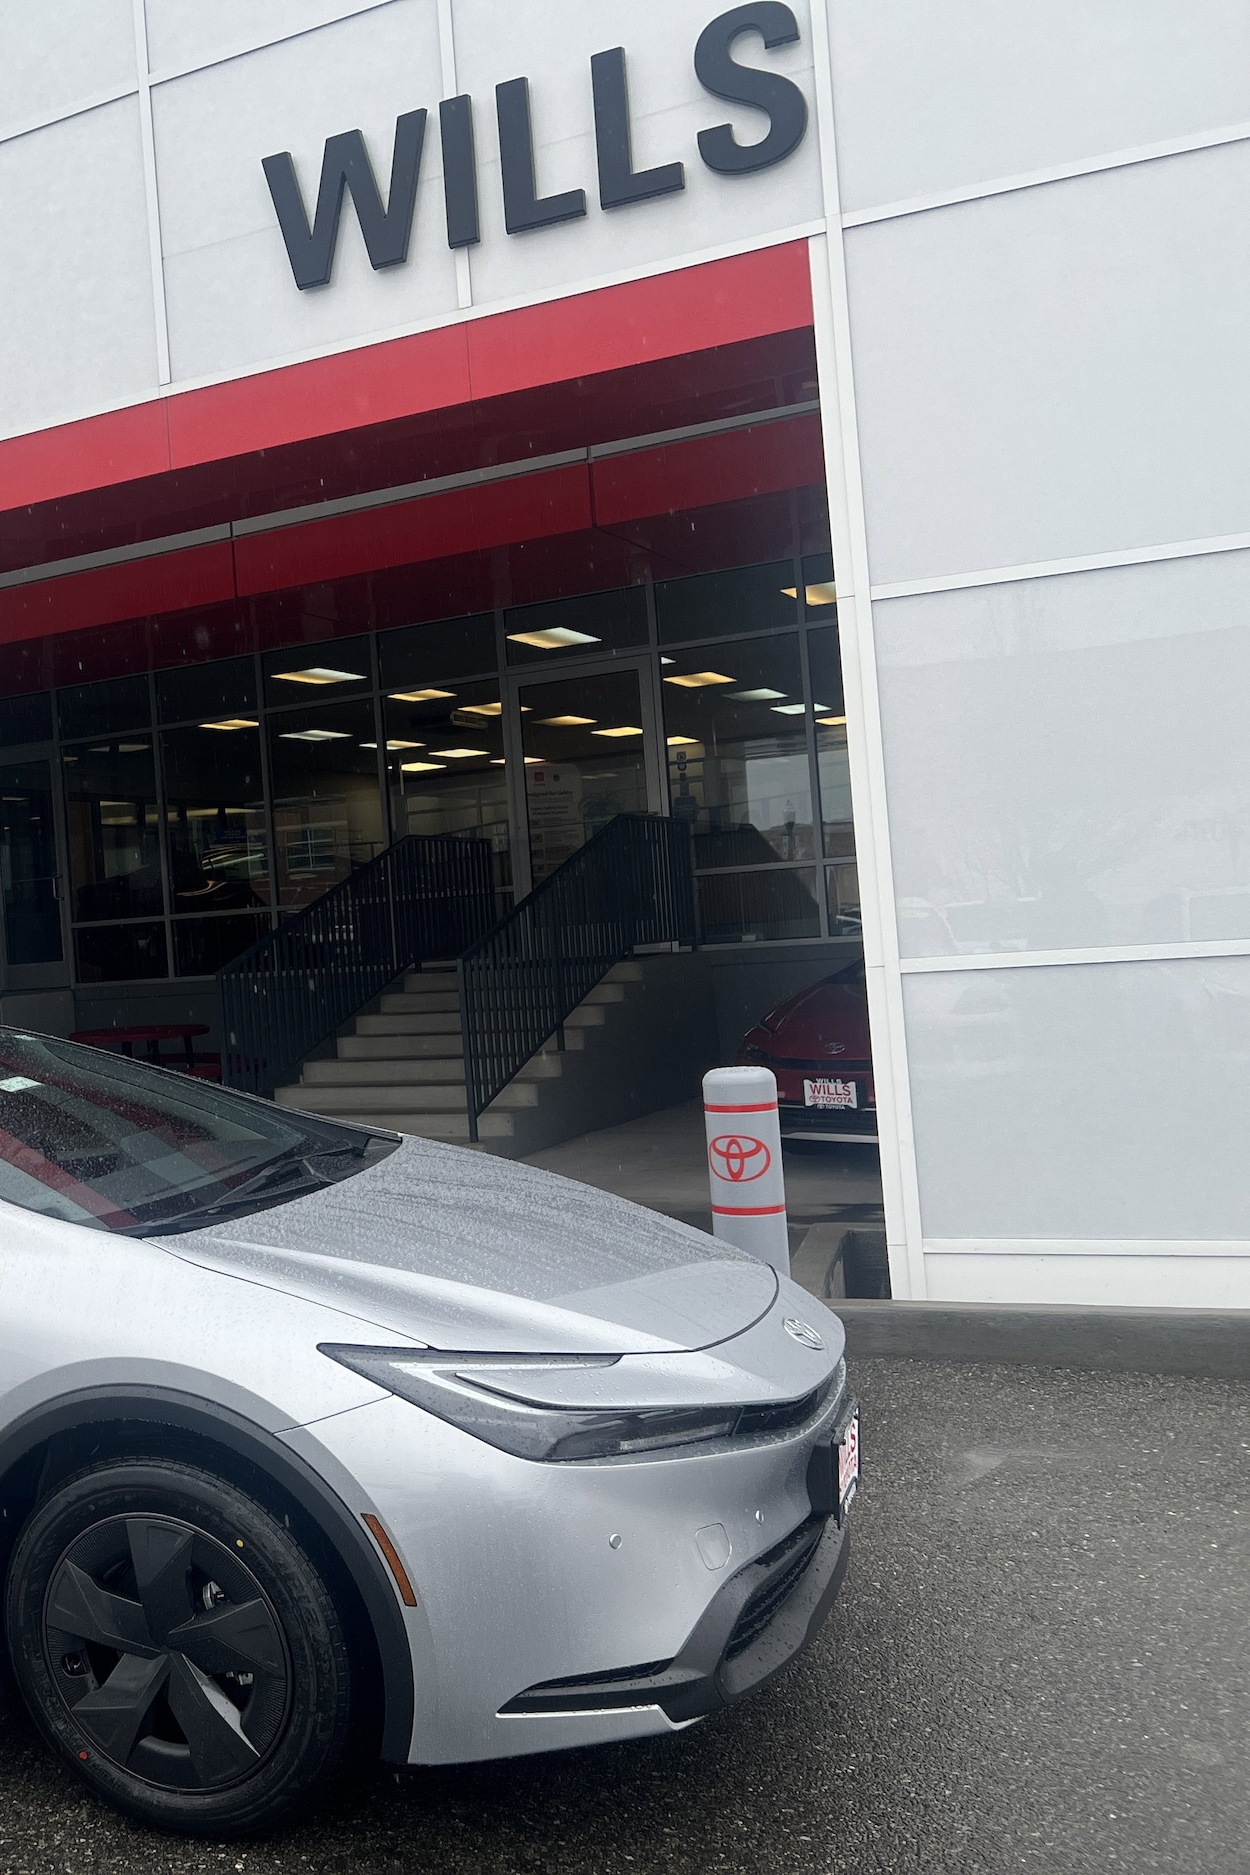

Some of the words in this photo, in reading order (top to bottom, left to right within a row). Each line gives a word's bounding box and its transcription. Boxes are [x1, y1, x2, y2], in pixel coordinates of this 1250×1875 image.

[261, 0, 809, 291] WILLS
[810, 1084, 851, 1096] WILLS
[821, 1096, 853, 1104] TOYOTA
